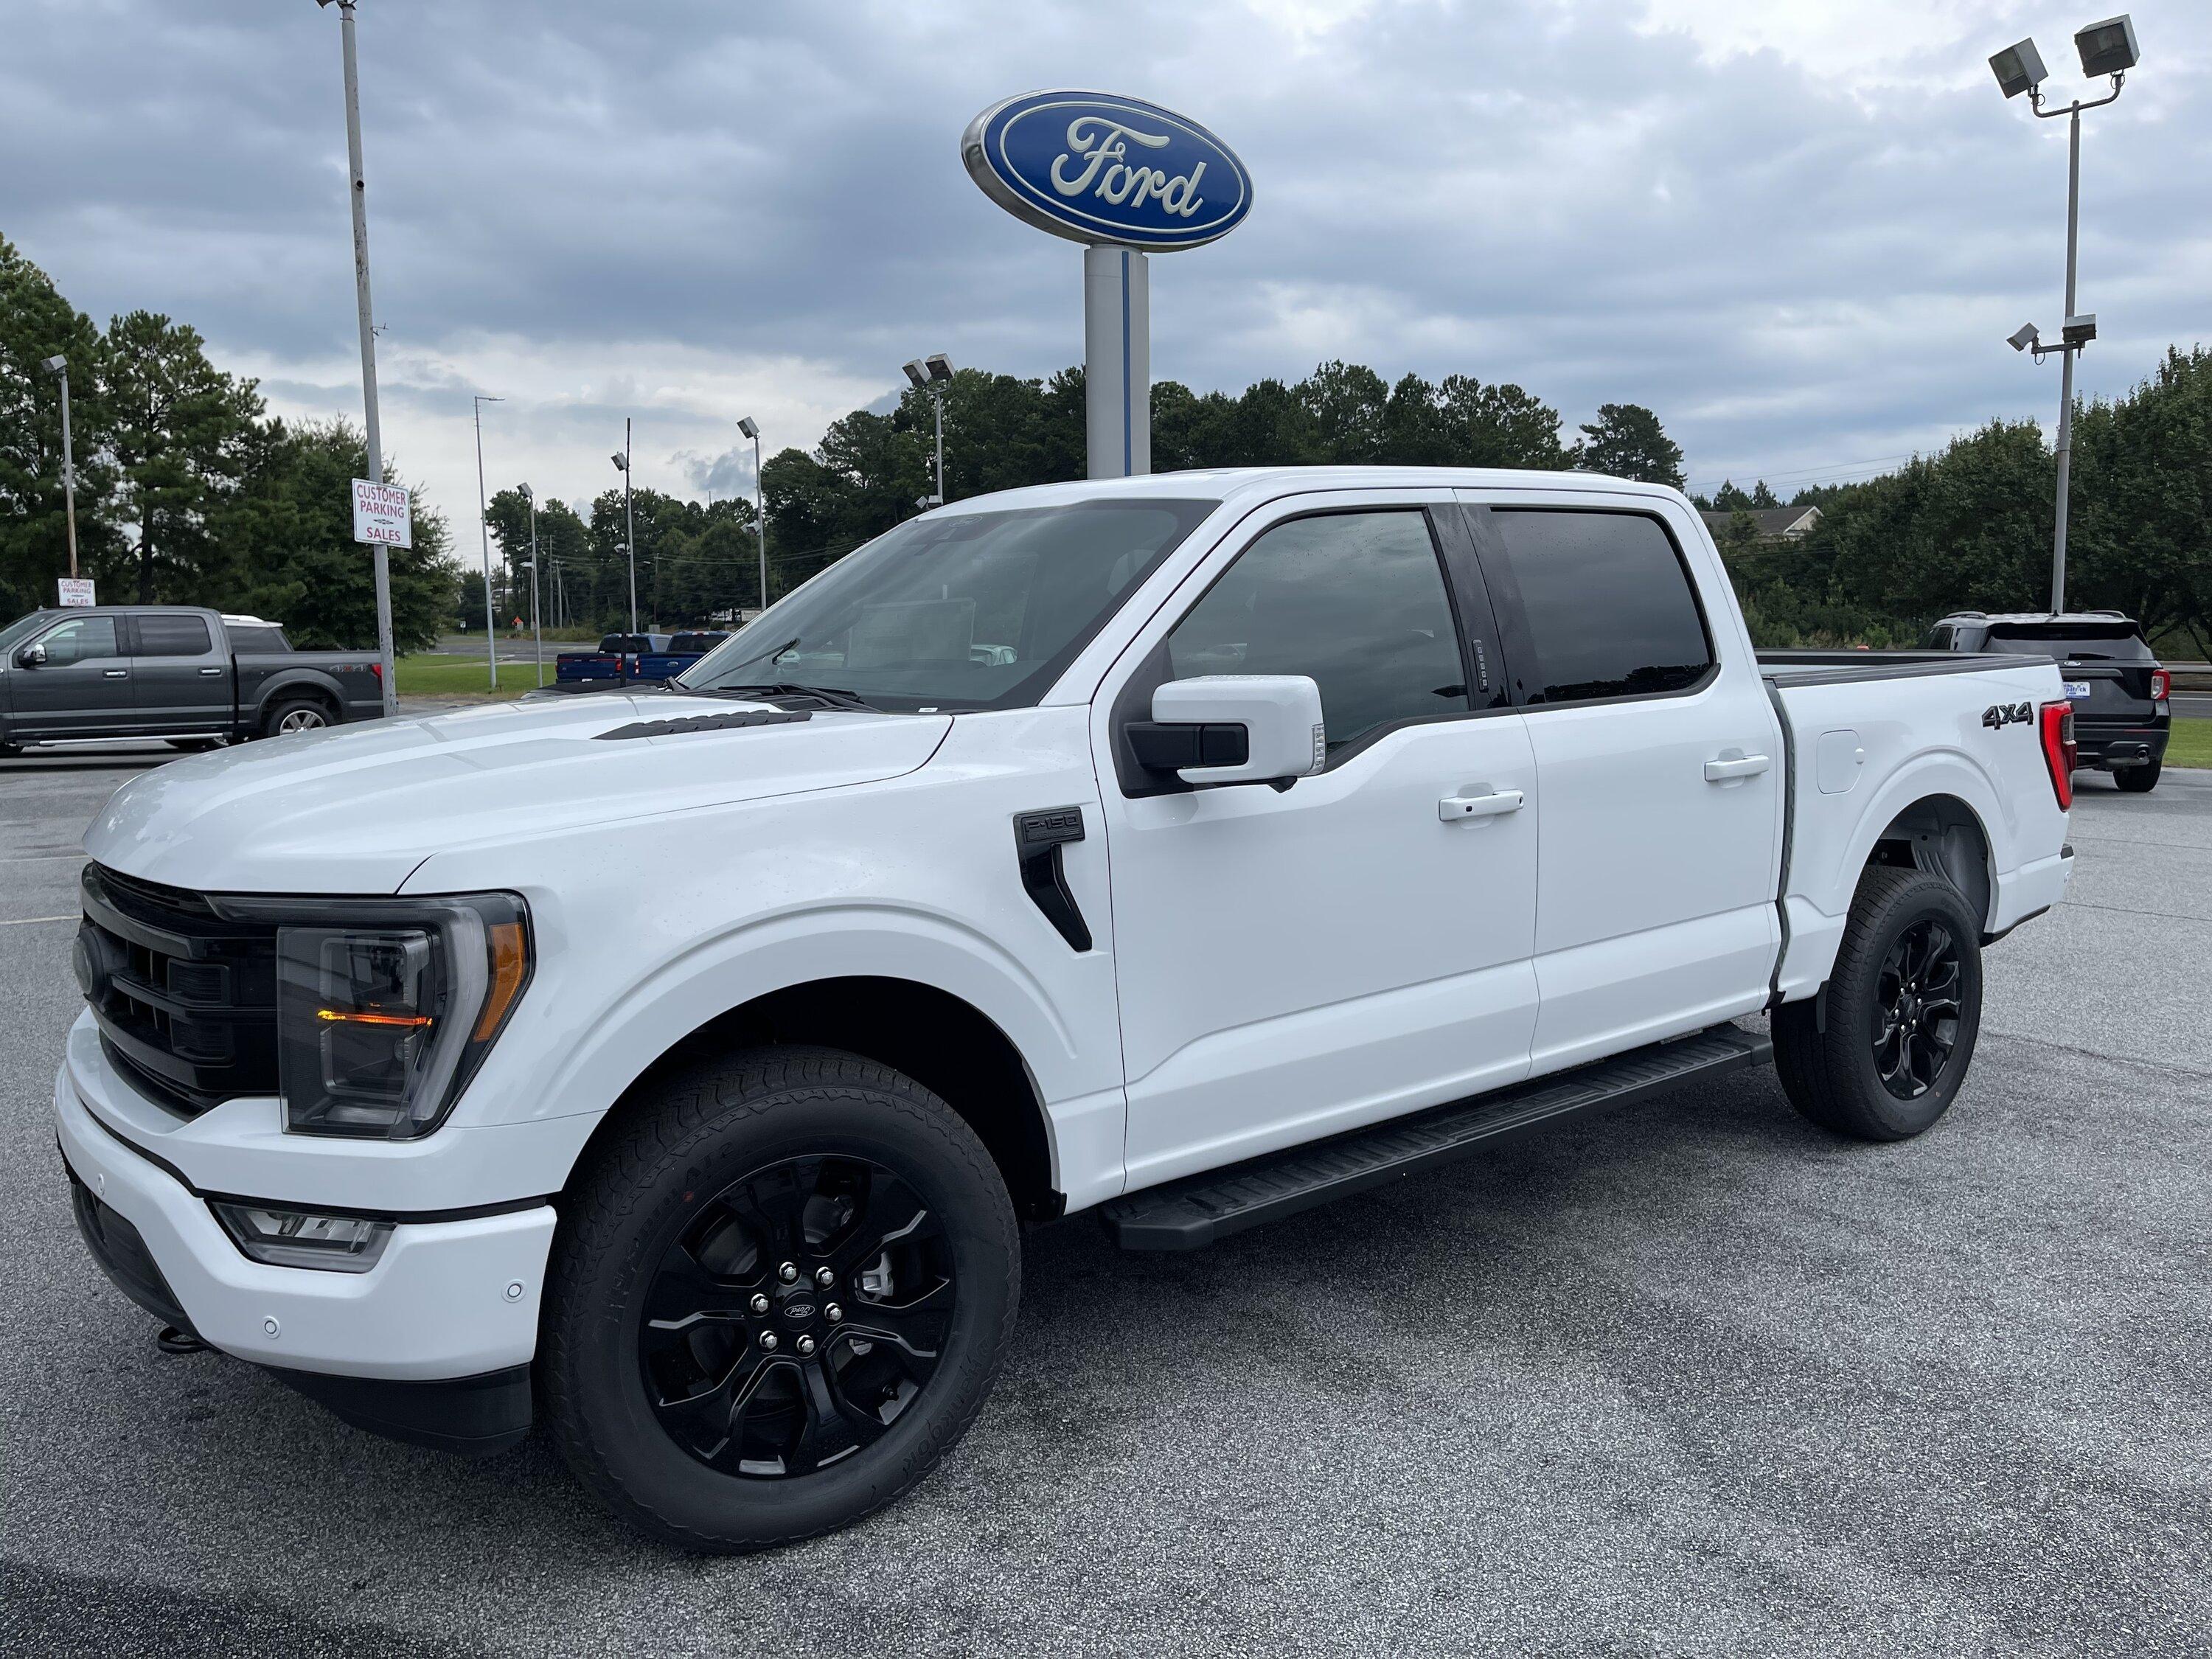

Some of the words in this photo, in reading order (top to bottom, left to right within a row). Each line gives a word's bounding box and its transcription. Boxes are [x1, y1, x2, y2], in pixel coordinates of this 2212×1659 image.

[1050, 116, 1207, 218] Ford
[357, 484, 406, 506] CUSTOMER
[360, 501, 405, 518] PARKING
[366, 526, 401, 542] SALES
[1023, 814, 1079, 832] F-150
[790, 1306, 810, 1316] Ford
